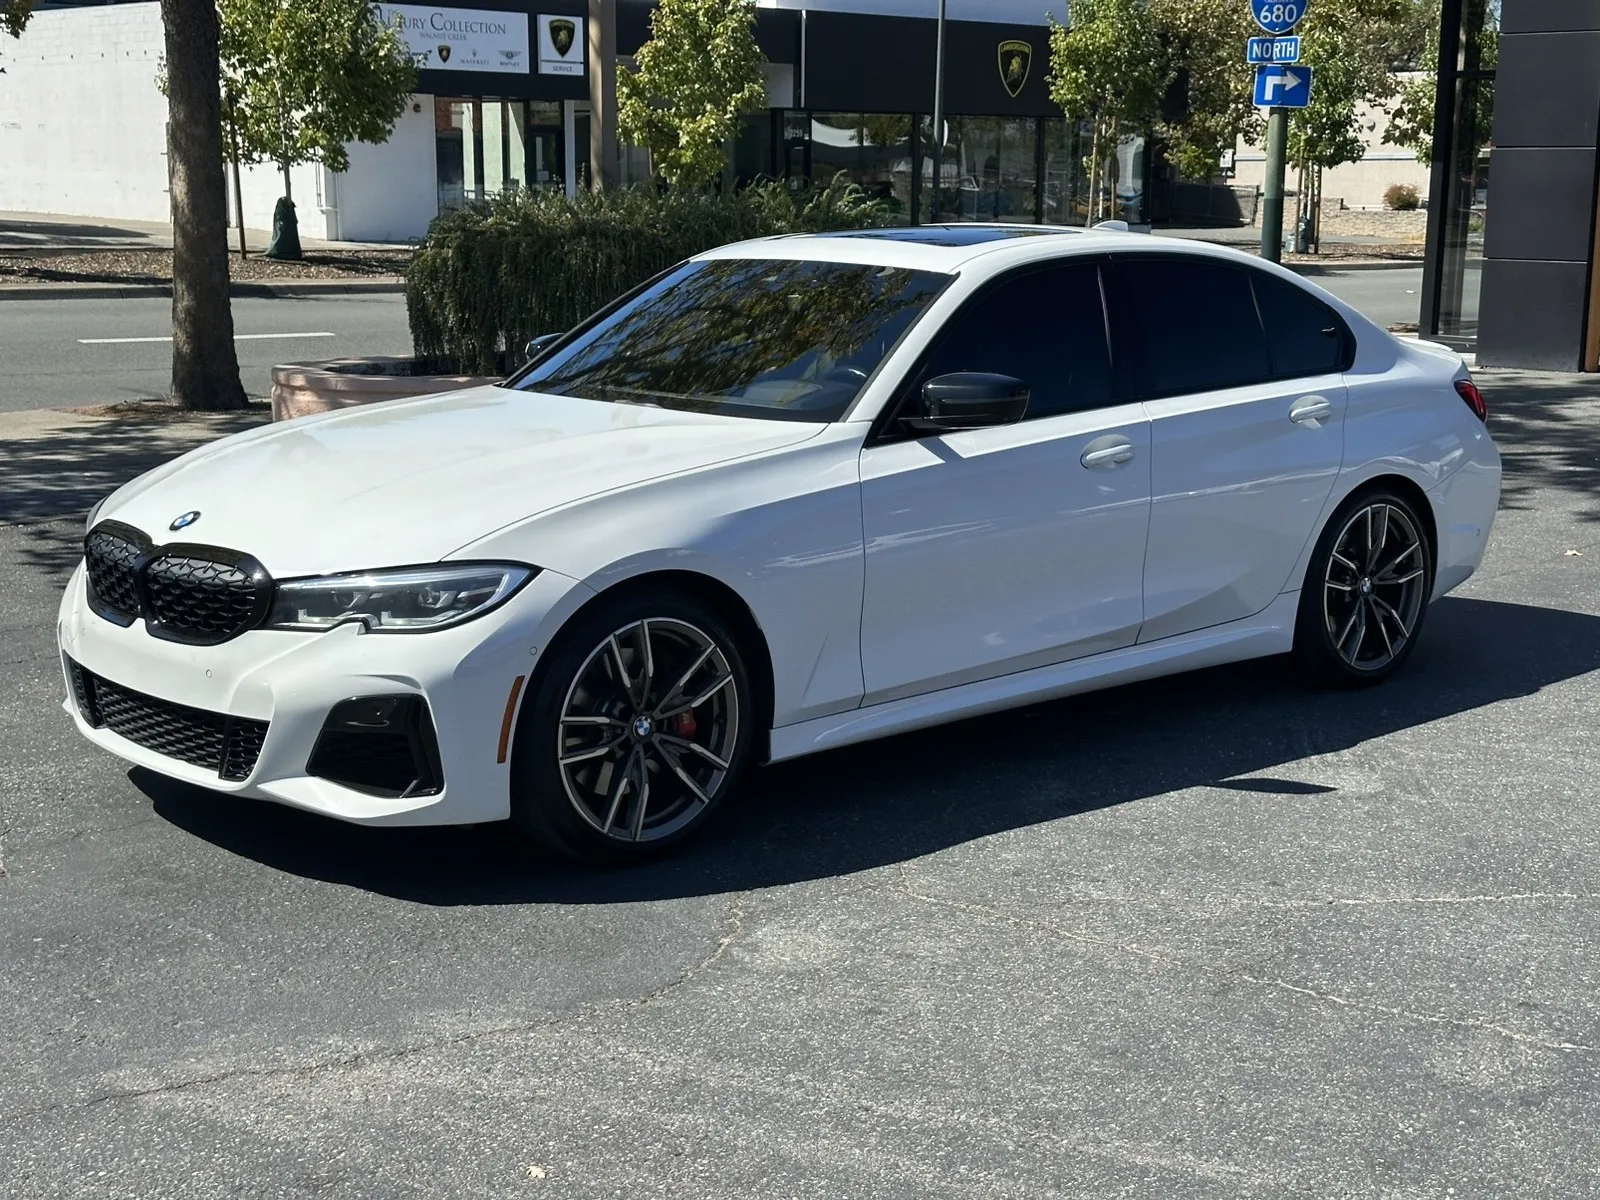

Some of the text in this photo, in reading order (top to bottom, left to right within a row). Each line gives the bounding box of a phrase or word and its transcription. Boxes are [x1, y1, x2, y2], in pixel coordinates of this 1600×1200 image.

[1260, 4, 1297, 23] 680
[430, 12, 506, 35] COLLECTION
[419, 31, 468, 41] WALNUT CREEK
[1252, 41, 1295, 60] NORTH
